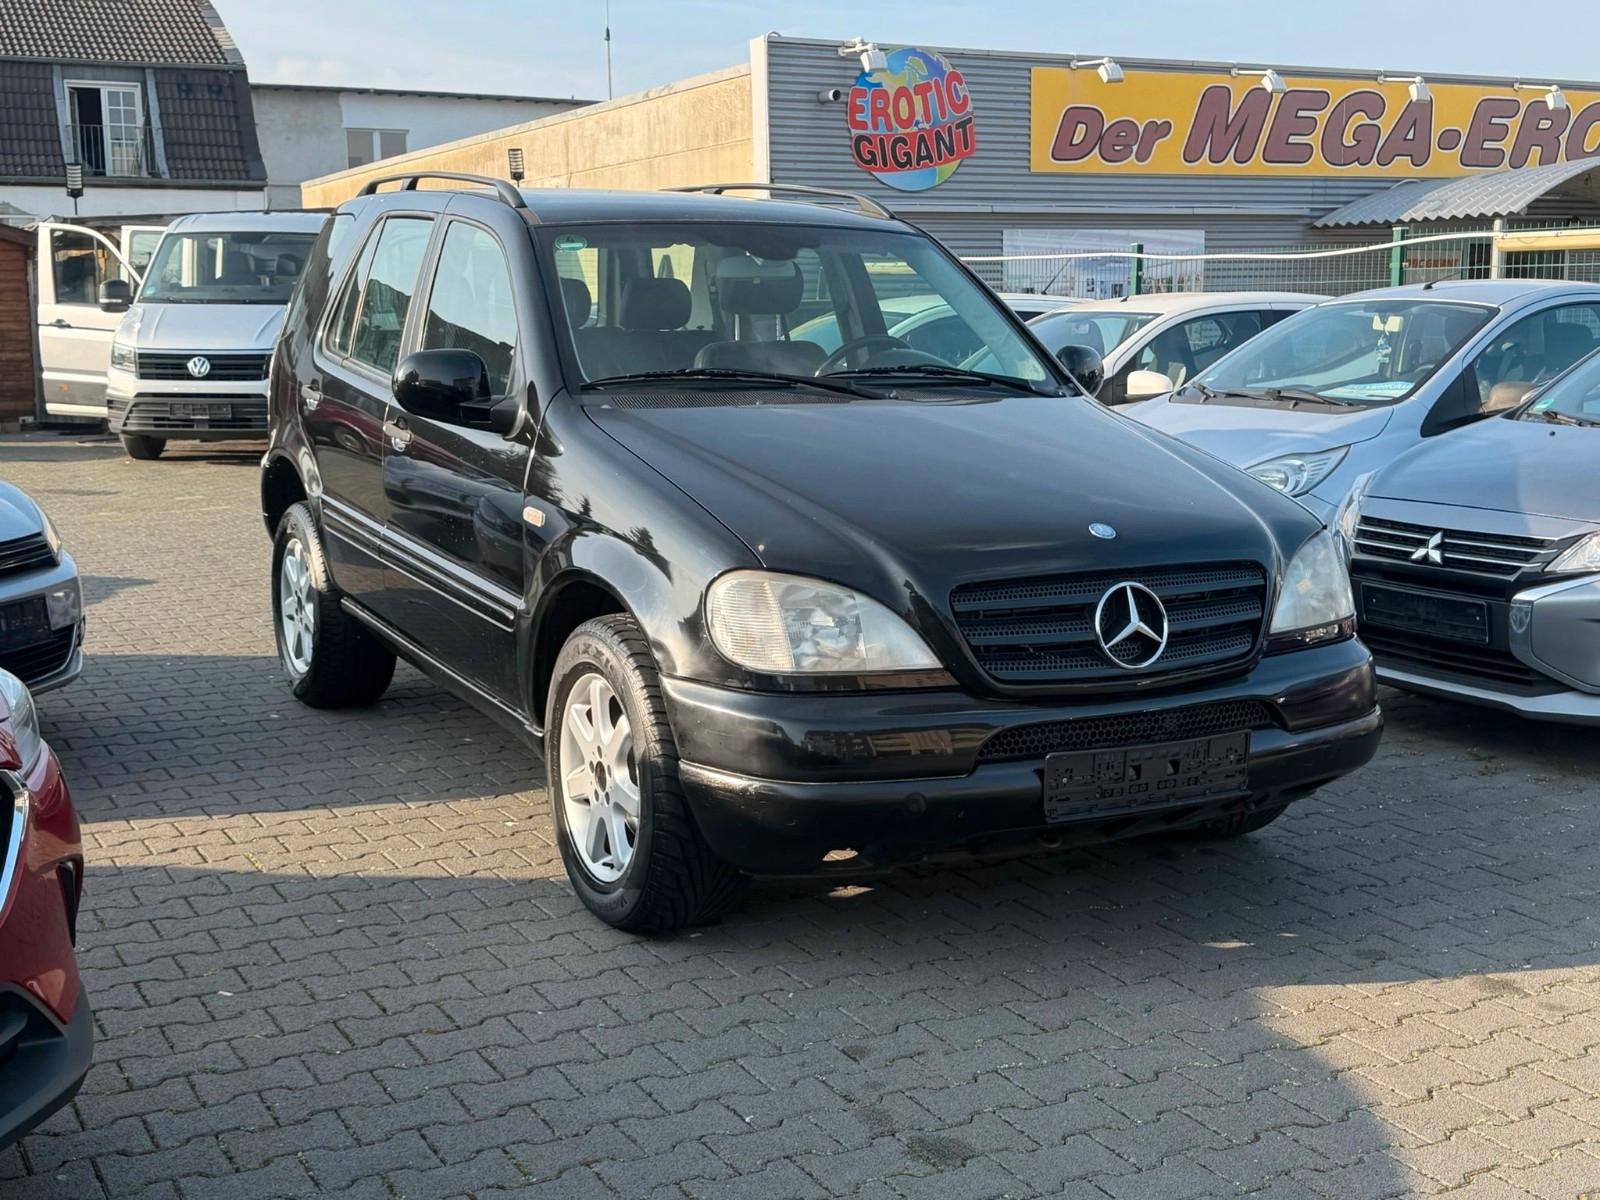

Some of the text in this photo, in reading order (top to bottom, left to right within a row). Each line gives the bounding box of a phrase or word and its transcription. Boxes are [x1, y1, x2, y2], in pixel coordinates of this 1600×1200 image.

[848, 70, 970, 132] EROTIC
[854, 116, 973, 169] GIGANT
[1051, 105, 1172, 164] Der
